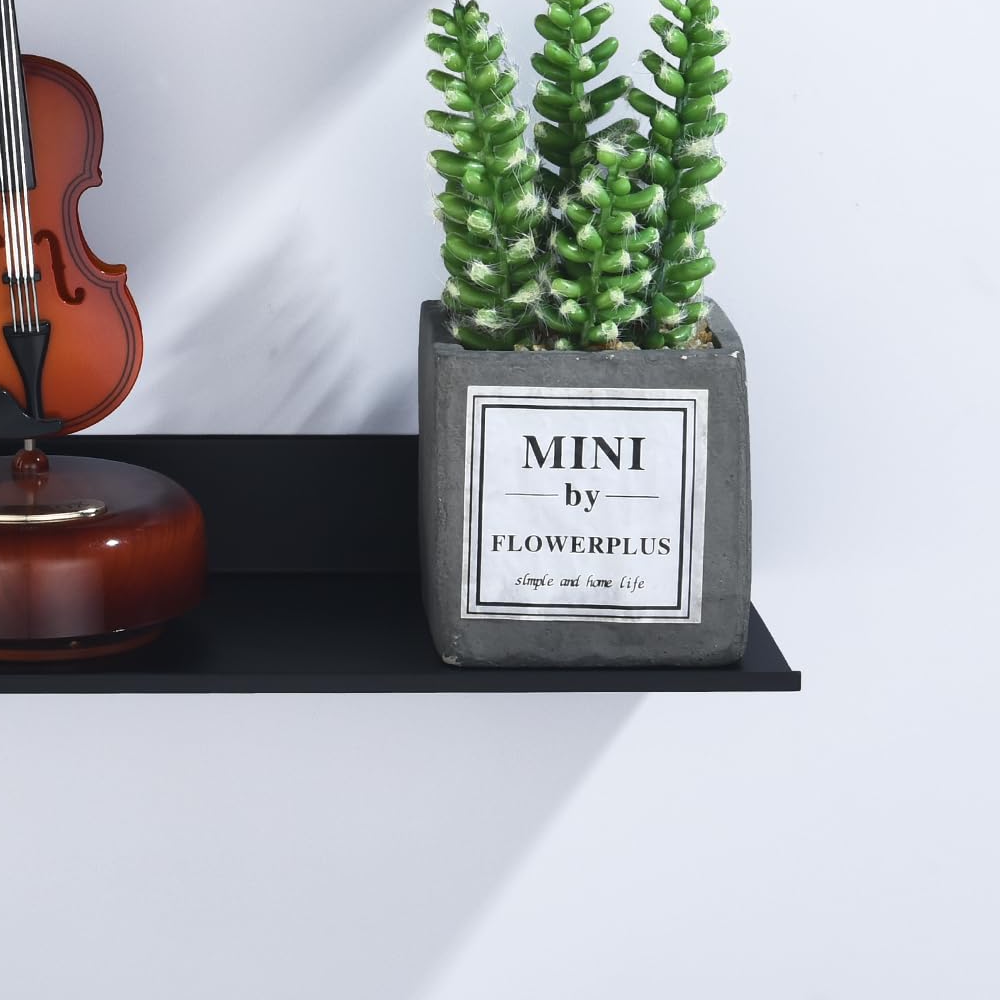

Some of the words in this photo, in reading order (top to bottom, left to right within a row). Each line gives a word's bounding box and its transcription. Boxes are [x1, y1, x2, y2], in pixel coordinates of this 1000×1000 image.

[521, 435, 646, 471] MINI
[565, 483, 600, 512] by
[491, 534, 671, 556] FLOWERPLUS
[560, 574, 581, 587] and
[619, 576, 645, 593] life
